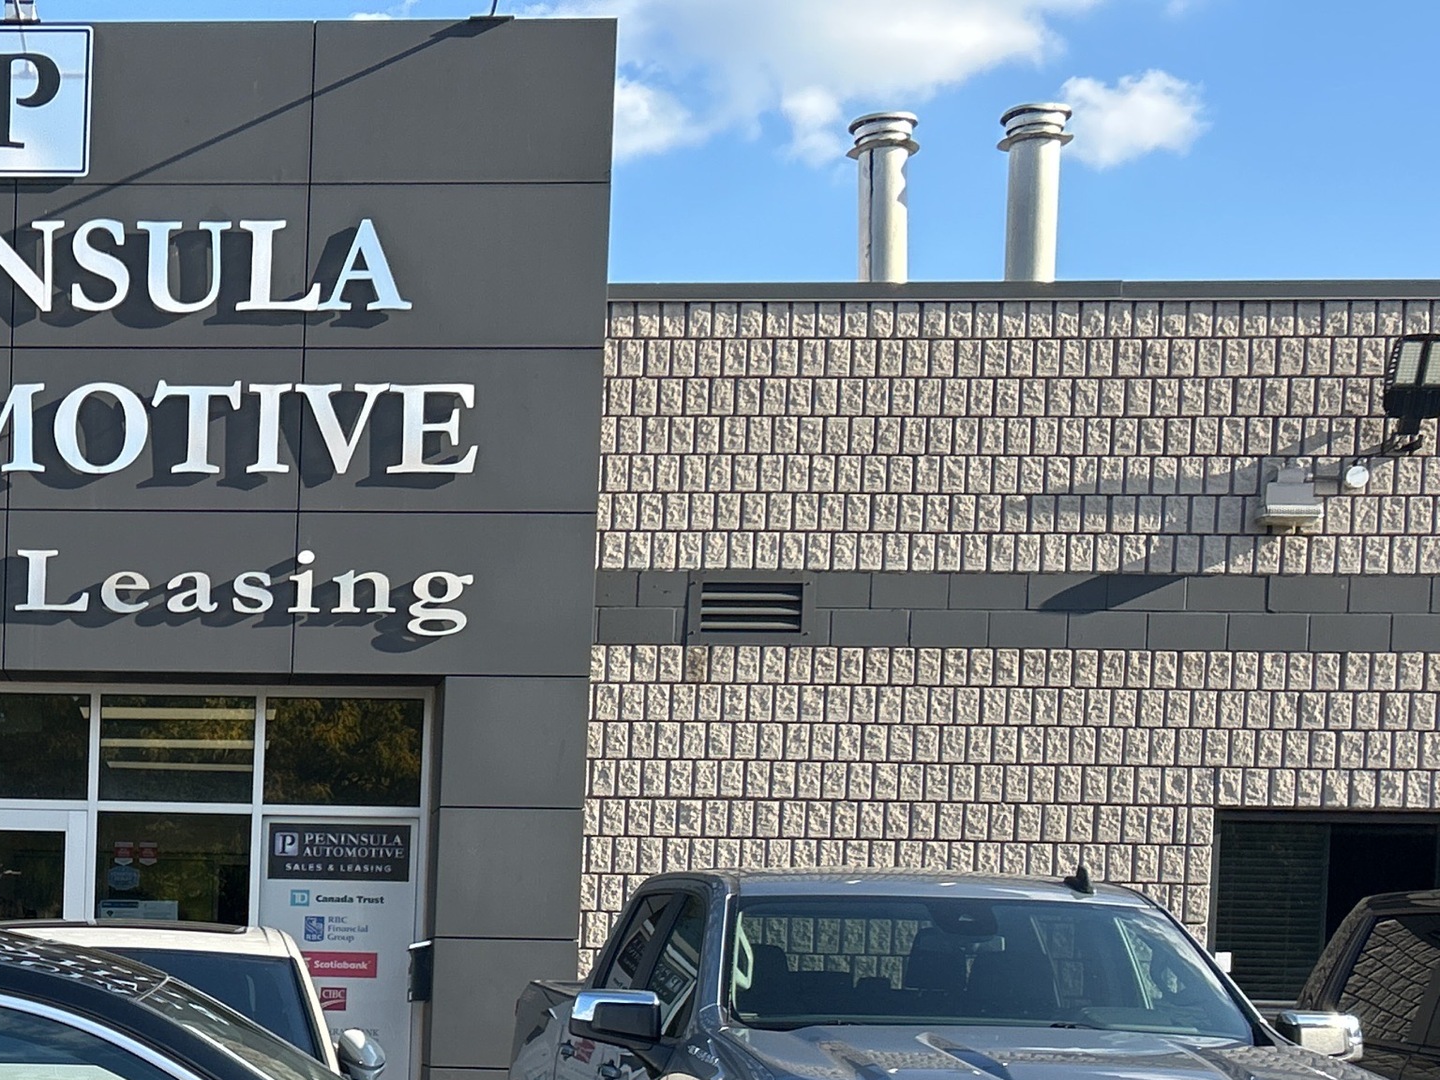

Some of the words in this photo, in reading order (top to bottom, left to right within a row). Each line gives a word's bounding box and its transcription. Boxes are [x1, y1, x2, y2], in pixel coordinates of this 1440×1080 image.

[14, 548, 474, 636] Leasing
[279, 834, 296, 855] P
[304, 832, 403, 846] PENINSULA
[303, 846, 404, 859] AUTOMOTIVE
[285, 863, 322, 871] SALES
[327, 864, 335, 872] &
[340, 864, 392, 873] LEASING
[292, 892, 308, 902] TD
[315, 894, 354, 904] Canada
[356, 895, 385, 904] Trust
[328, 916, 348, 924] RBC
[327, 924, 369, 933] Financial
[327, 934, 355, 944] Group
[314, 959, 368, 970] Scotiabank
[322, 989, 346, 999] CIBC
